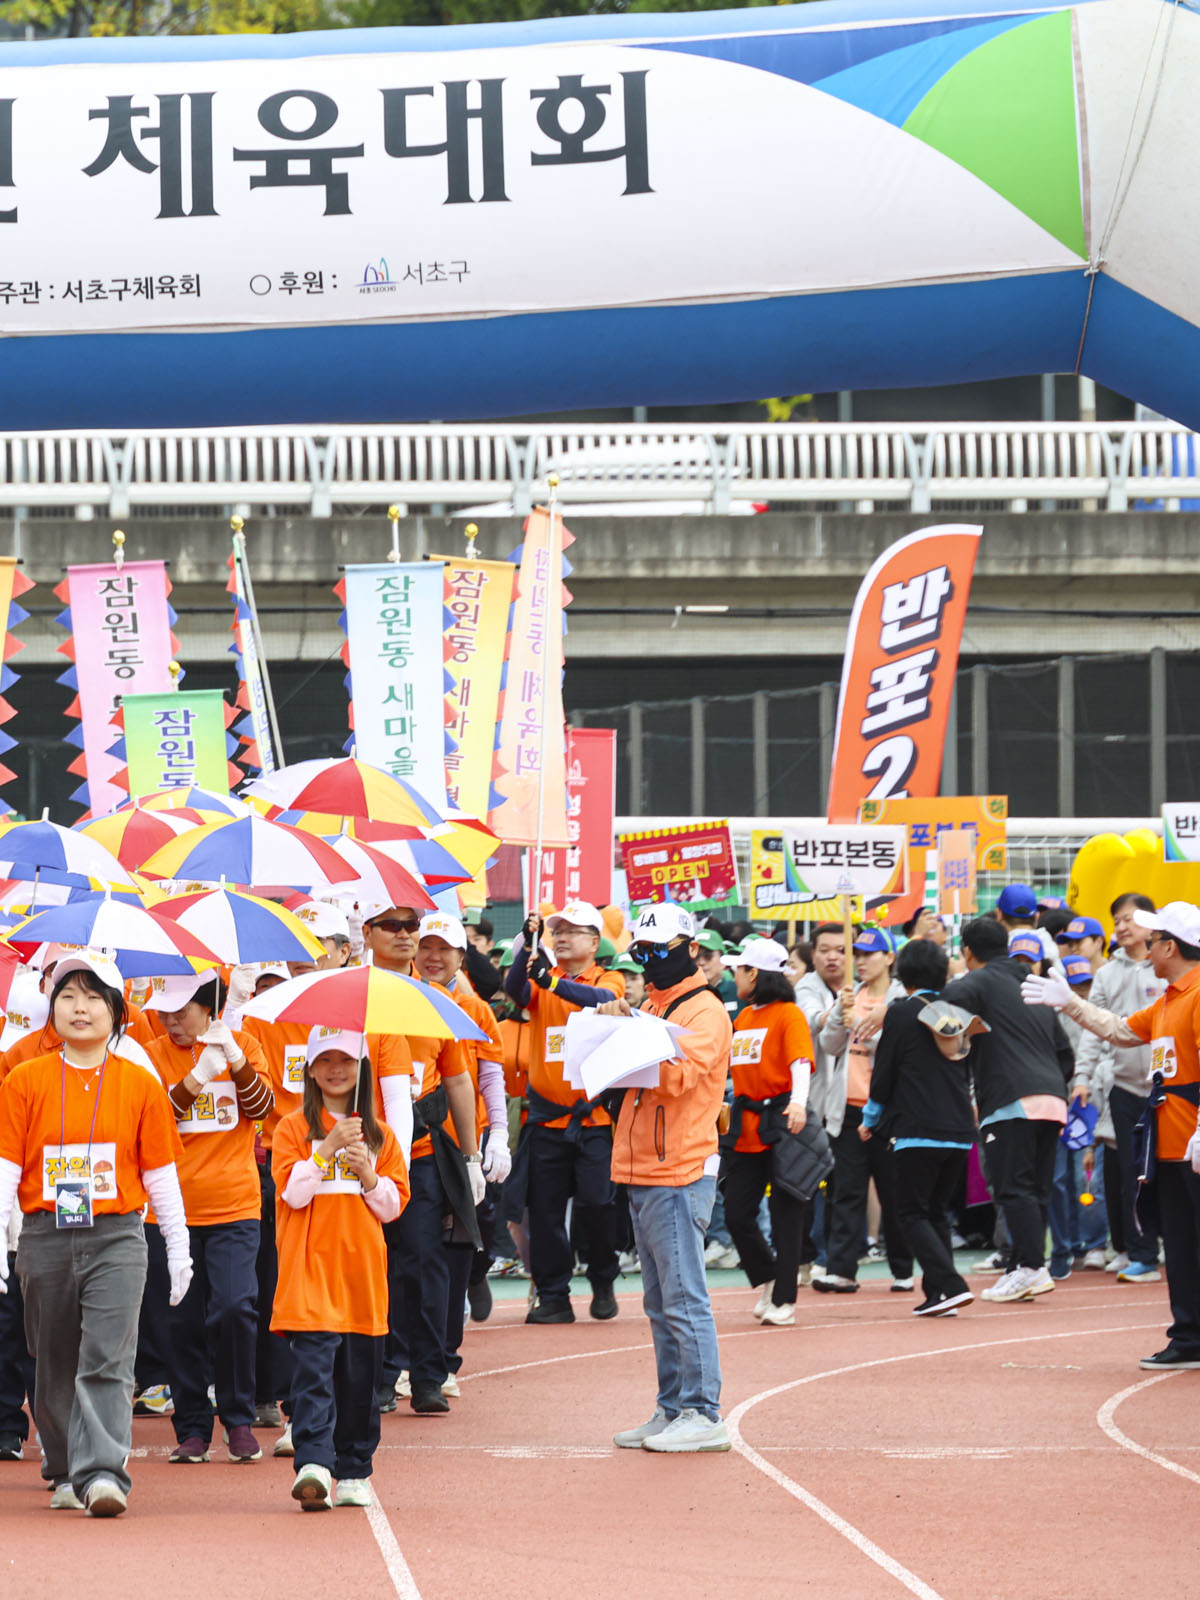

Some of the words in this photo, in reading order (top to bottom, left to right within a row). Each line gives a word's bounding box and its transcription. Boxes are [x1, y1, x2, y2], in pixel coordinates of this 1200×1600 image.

[81, 69, 657, 219] 체육대회
[62, 273, 201, 303] 서초구체육회
[403, 261, 471, 285] 서초구
[98, 577, 144, 679] 잠원동
[375, 575, 416, 669] 잠원동
[450, 570, 487, 663] 잠원동
[861, 566, 951, 799] 반포2
[381, 683, 418, 776] 새마을
[1176, 815, 1200, 838] 반
[793, 840, 896, 869] 반포본동
[655, 863, 706, 882] OPEN
[640, 913, 657, 927] LA
[287, 1056, 305, 1082] 잠
